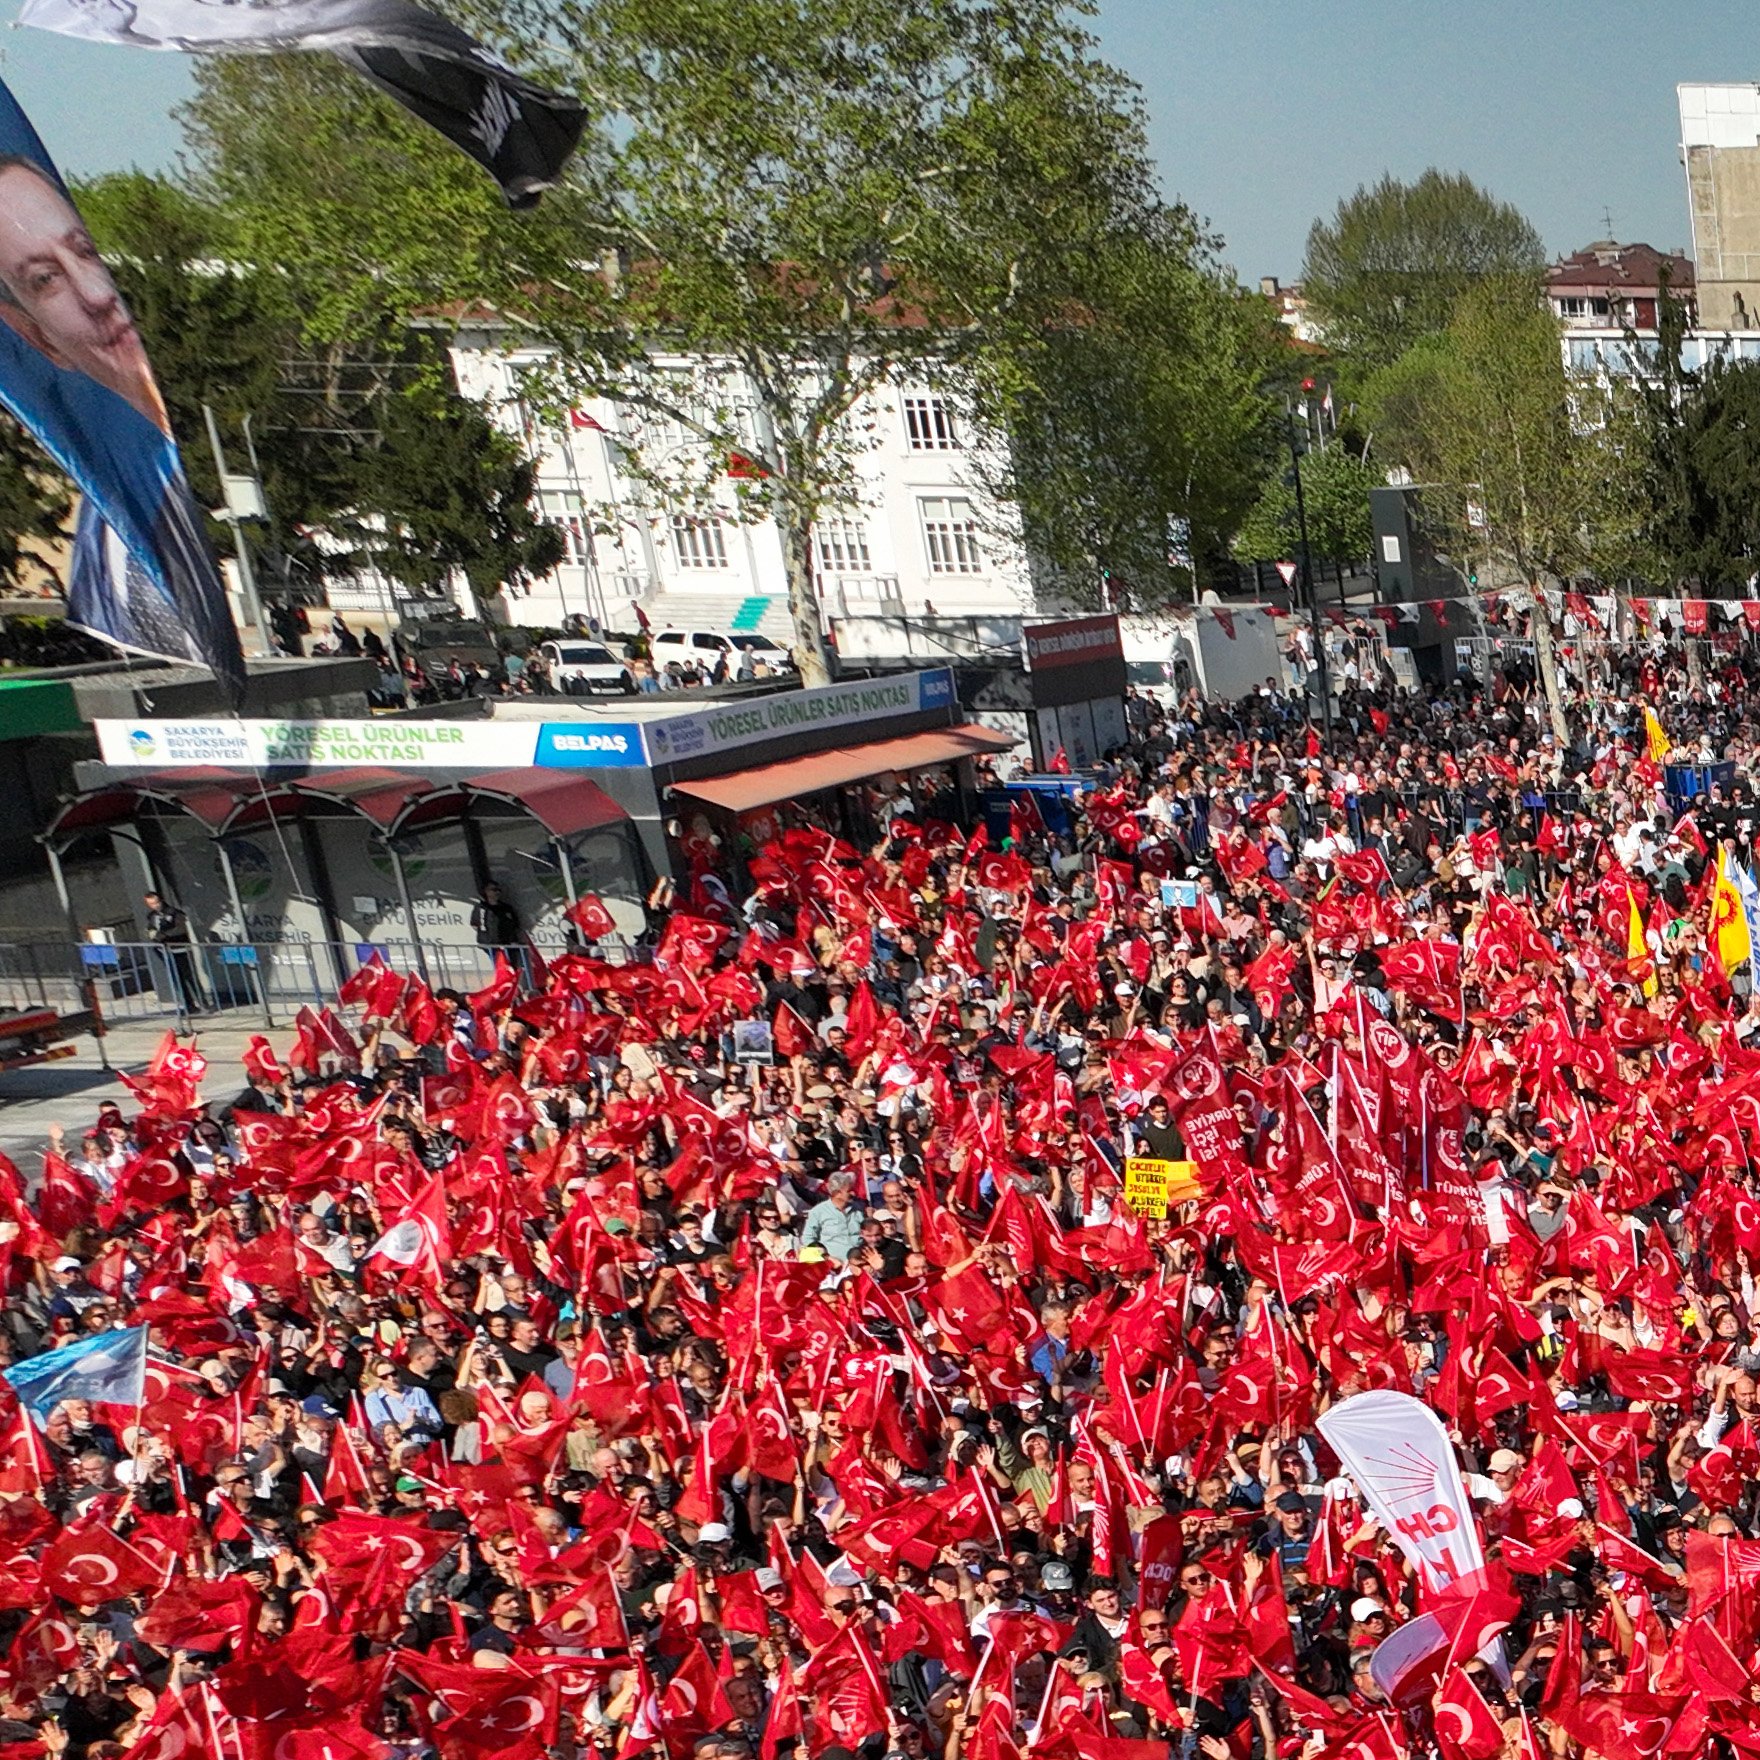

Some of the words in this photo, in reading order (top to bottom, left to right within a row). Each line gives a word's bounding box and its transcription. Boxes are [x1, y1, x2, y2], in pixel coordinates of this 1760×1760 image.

[261, 723, 359, 742] YÖRESEL
[363, 723, 464, 742] ÜRÜNLER
[266, 745, 326, 761] SATIŞ
[331, 745, 425, 760] NOKTASI
[552, 735, 629, 753] BELPAŞ
[1376, 1030, 1398, 1048] TİP
